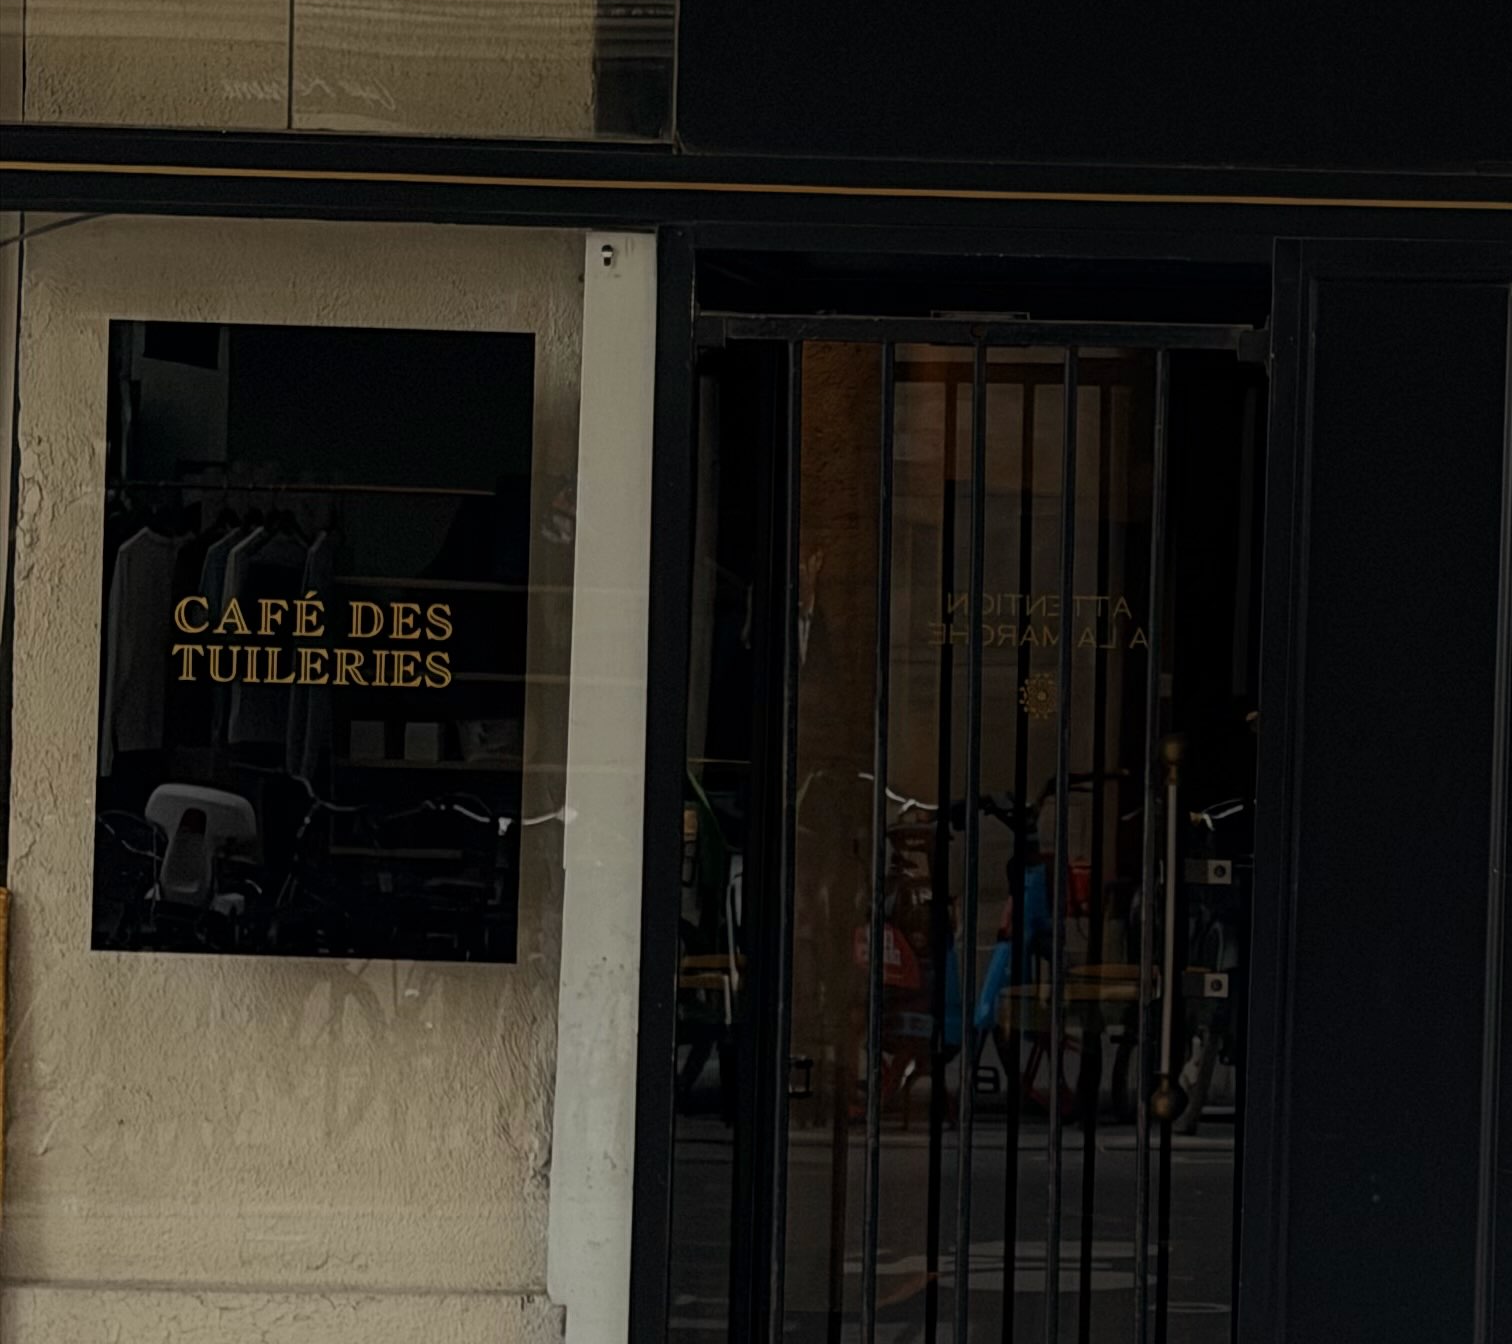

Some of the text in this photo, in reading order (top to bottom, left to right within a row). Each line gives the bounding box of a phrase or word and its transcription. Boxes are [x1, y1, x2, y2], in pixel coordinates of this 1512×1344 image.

[173, 590, 453, 641] CAFÉ DES
[171, 643, 452, 688] TUILERIES
